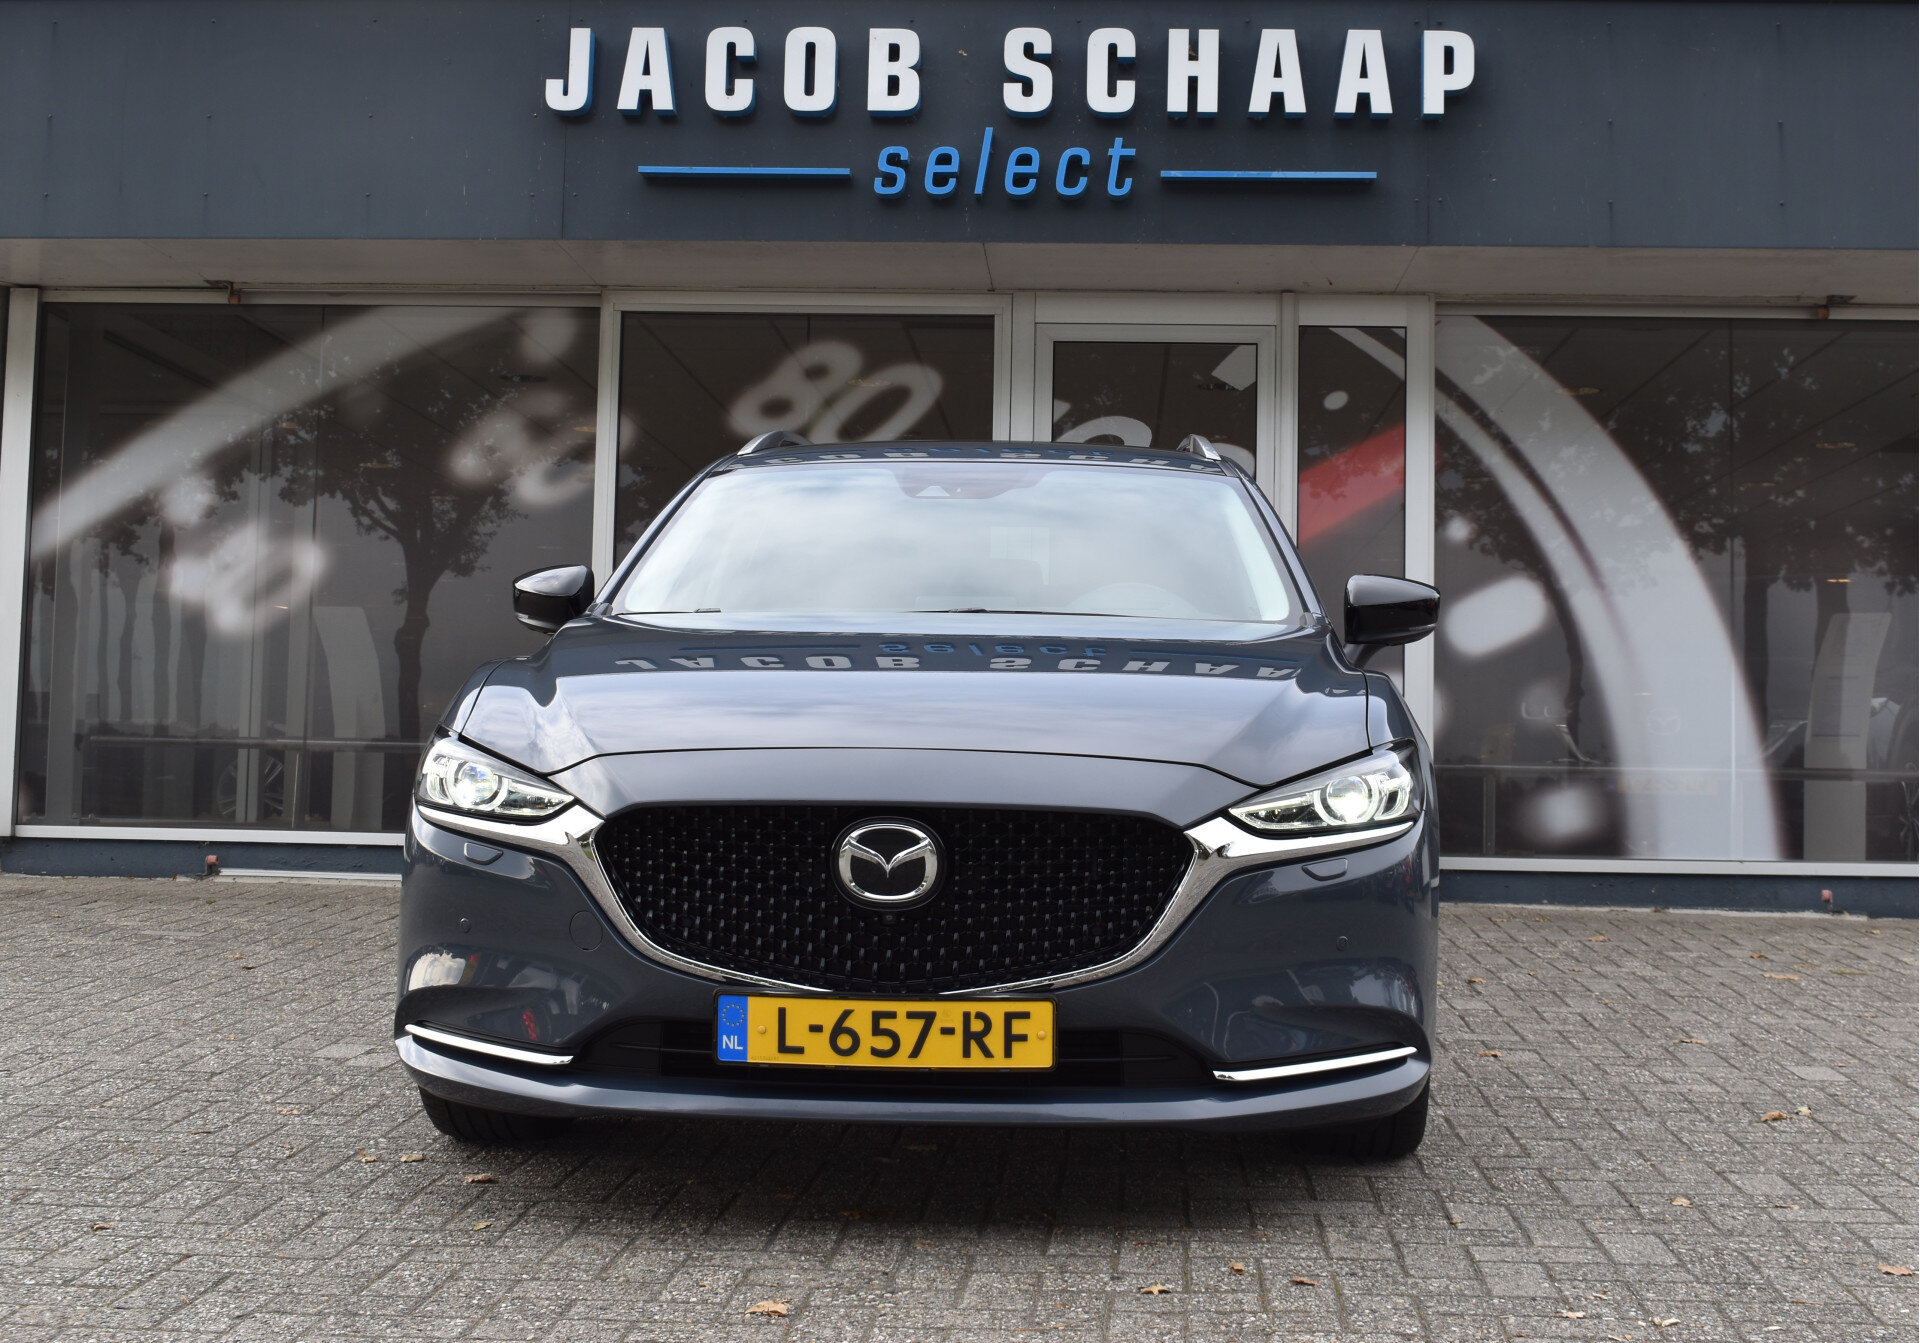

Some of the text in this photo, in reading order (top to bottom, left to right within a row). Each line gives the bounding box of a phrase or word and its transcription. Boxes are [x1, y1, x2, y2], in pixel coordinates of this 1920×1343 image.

[545, 26, 1476, 118] JACOB SCHAAP
[873, 126, 1137, 199] select
[727, 339, 943, 442] 80
[722, 1034, 744, 1051] NL
[777, 1006, 1031, 1060] L-657-RF
